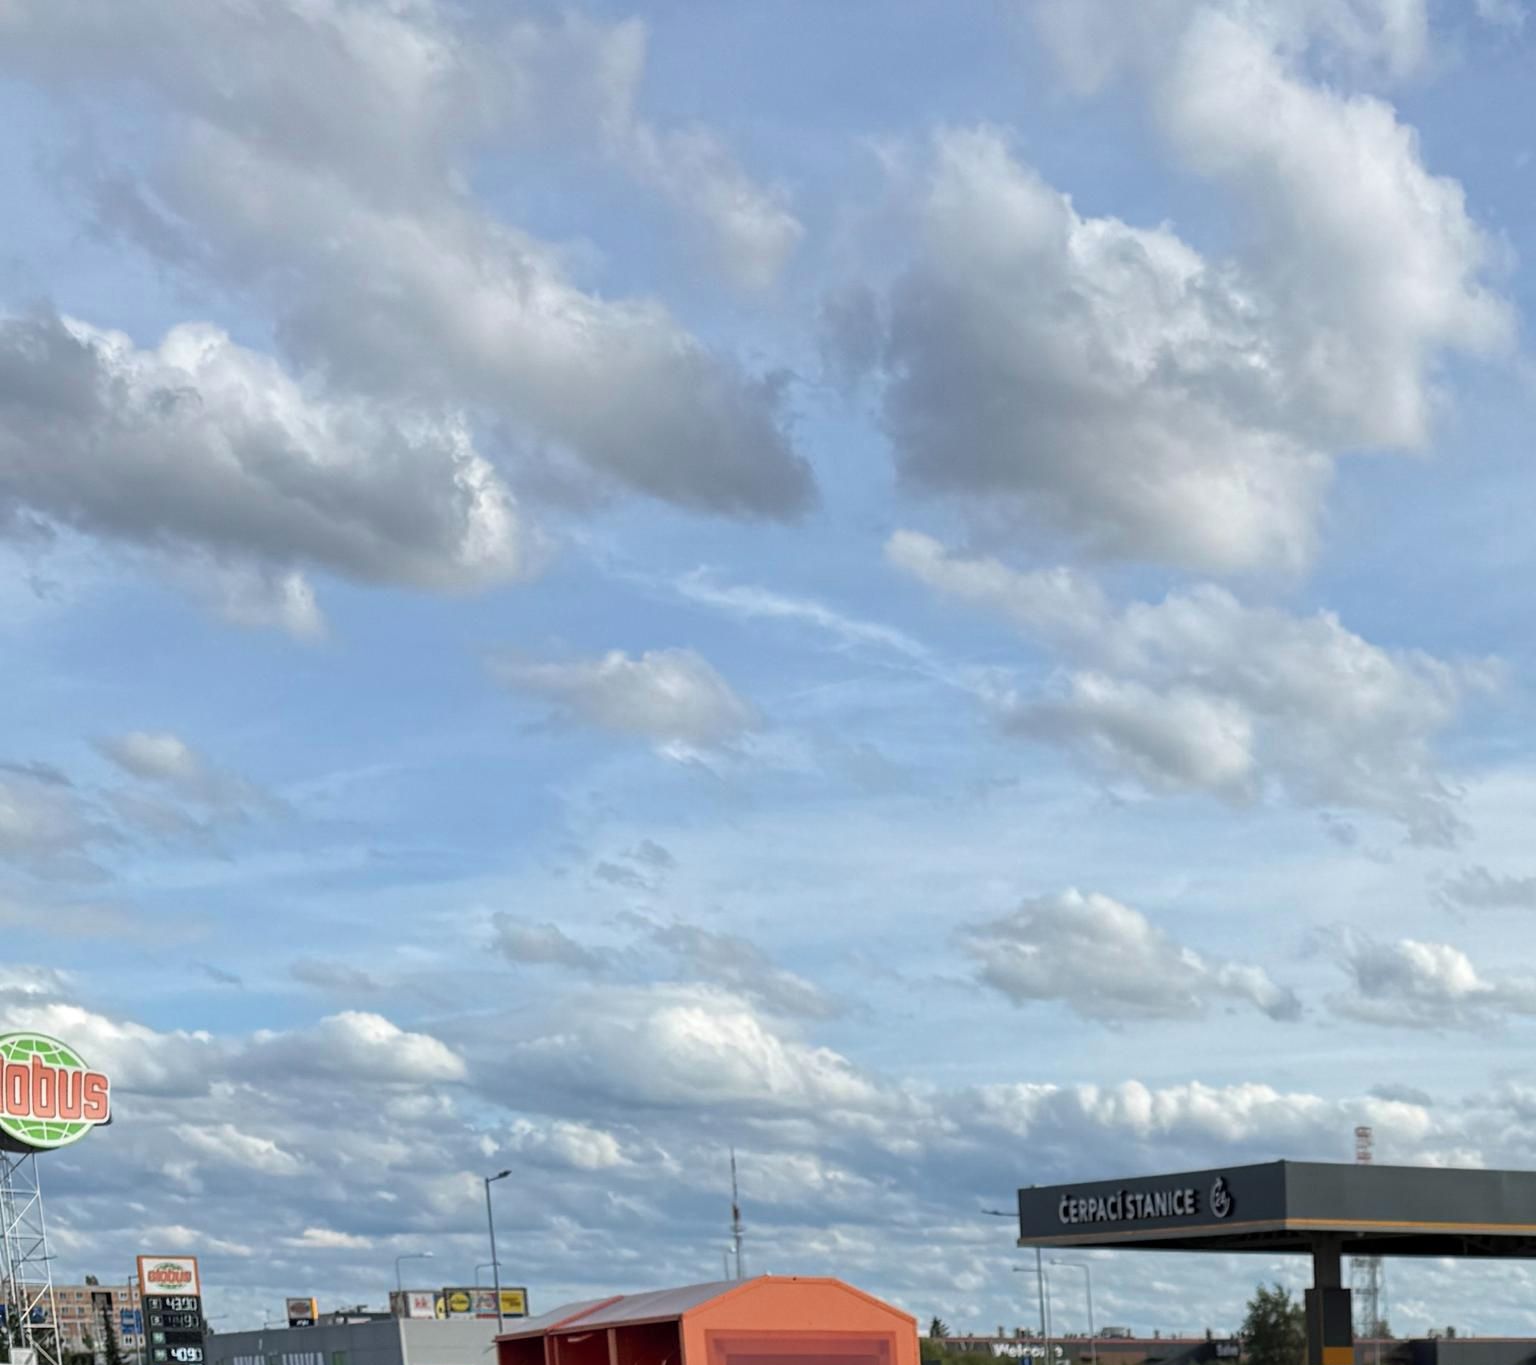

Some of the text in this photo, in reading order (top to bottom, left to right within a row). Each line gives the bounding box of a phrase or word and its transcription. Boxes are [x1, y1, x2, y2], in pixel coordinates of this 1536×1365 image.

[1059, 1188, 1195, 1224] ČERPACÍ STANICE
[991, 1343, 1064, 1358] Welcoe
